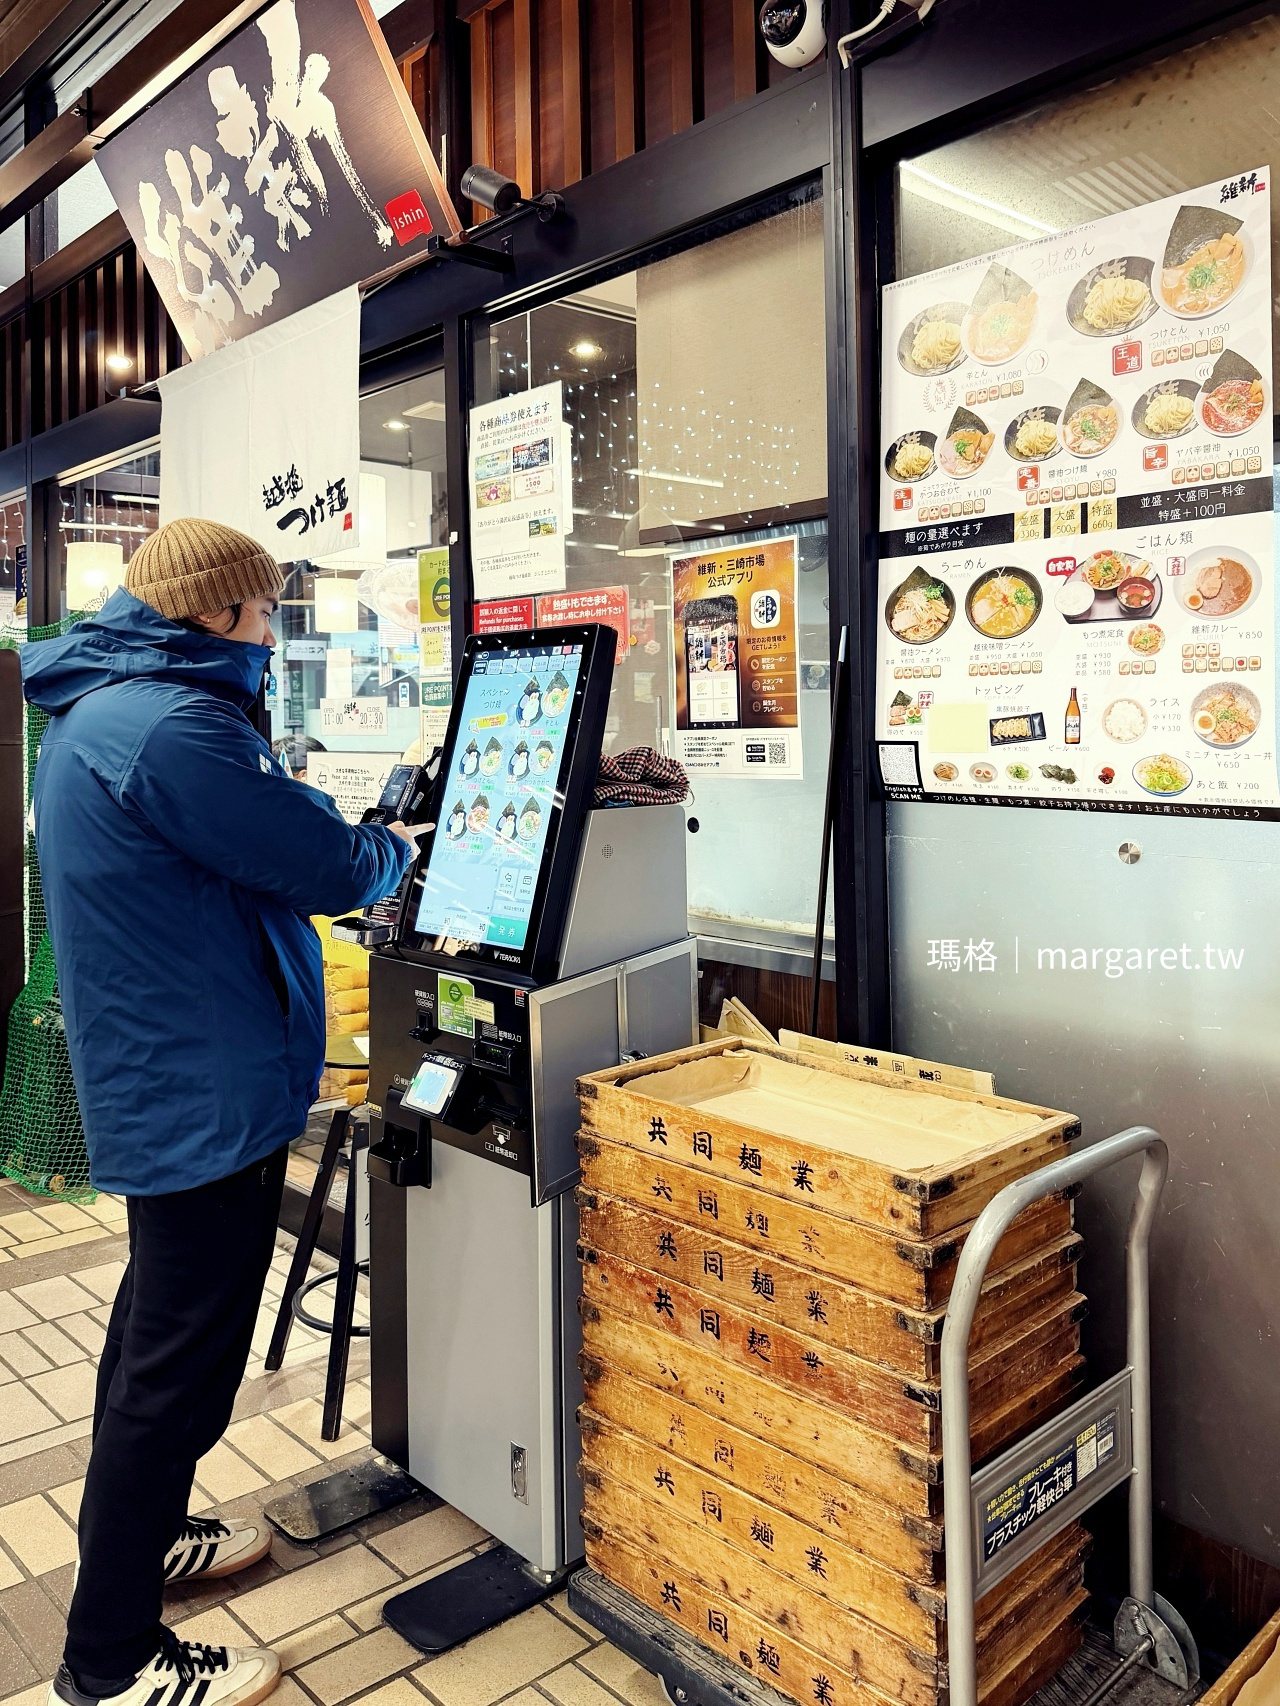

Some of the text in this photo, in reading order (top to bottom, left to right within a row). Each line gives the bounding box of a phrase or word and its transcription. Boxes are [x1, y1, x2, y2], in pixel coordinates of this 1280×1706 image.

[392, 206, 426, 230] ishin
[1031, 241, 1096, 271] つけめん
[1038, 262, 1082, 280] TSUKEMEN
[1150, 322, 1230, 340] つけとん ¥1,050
[1148, 334, 1190, 350] TSUKETON
[1116, 347, 1140, 371] 王道
[966, 369, 1022, 382] 辛とん ¥1,080
[961, 378, 993, 390] KARATON
[1175, 443, 1260, 459] ヤバ辛醤油 ¥1,050
[1145, 448, 1167, 469] 旨辛
[1176, 453, 1221, 465] YABAKARA
[1018, 467, 1039, 489] 定番
[1048, 464, 1117, 479] 醤油つけ麺 ¥980
[1055, 475, 1080, 485] SYOYU
[894, 490, 911, 507] 注目
[919, 486, 992, 499] かつお合わせ ¥1,100
[1140, 483, 1246, 509] 並盛・大盛同一料金
[276, 477, 349, 536] つけ麺
[1091, 503, 1113, 517] 特盛
[1020, 514, 1040, 527] 並盛
[1055, 509, 1076, 522] 大盛
[1056, 524, 1077, 535] 500g
[1092, 519, 1113, 530] 660g
[904, 522, 984, 545] 麺の量選べます
[1020, 529, 1040, 539] 330g
[1136, 530, 1194, 549] ごはん類
[1151, 548, 1169, 556] RICE
[697, 553, 765, 577] 維新・三崎市場
[941, 557, 987, 574] らーめん
[1048, 559, 1076, 573] 自家製
[707, 570, 754, 588] 公式アプリ
[503, 615, 525, 624] purchases
[1083, 628, 1125, 640] もつ煮定食
[1191, 624, 1263, 639] 維新カレー ¥850
[1196, 633, 1226, 641] CURRY
[900, 647, 942, 657] 醤油ラーメン
[973, 641, 1034, 652] 越後味噌ラーメン
[1093, 652, 1112, 660] ¥930
[974, 684, 1025, 696] トッピング
[1150, 697, 1180, 707] ライス
[359, 712, 384, 725] 20:30
[1162, 713, 1182, 721] ¥170
[1184, 750, 1273, 760] ミニチャーシュー丼
[1217, 761, 1240, 769] ¥650
[1196, 781, 1260, 790] あと飯 ¥200
[890, 792, 910, 800] SCAN
[498, 926, 516, 938] 発券
[1028, 1461, 1073, 1504] ブレーキ付き
[987, 1473, 1073, 1555] プラスチック軽快台車
